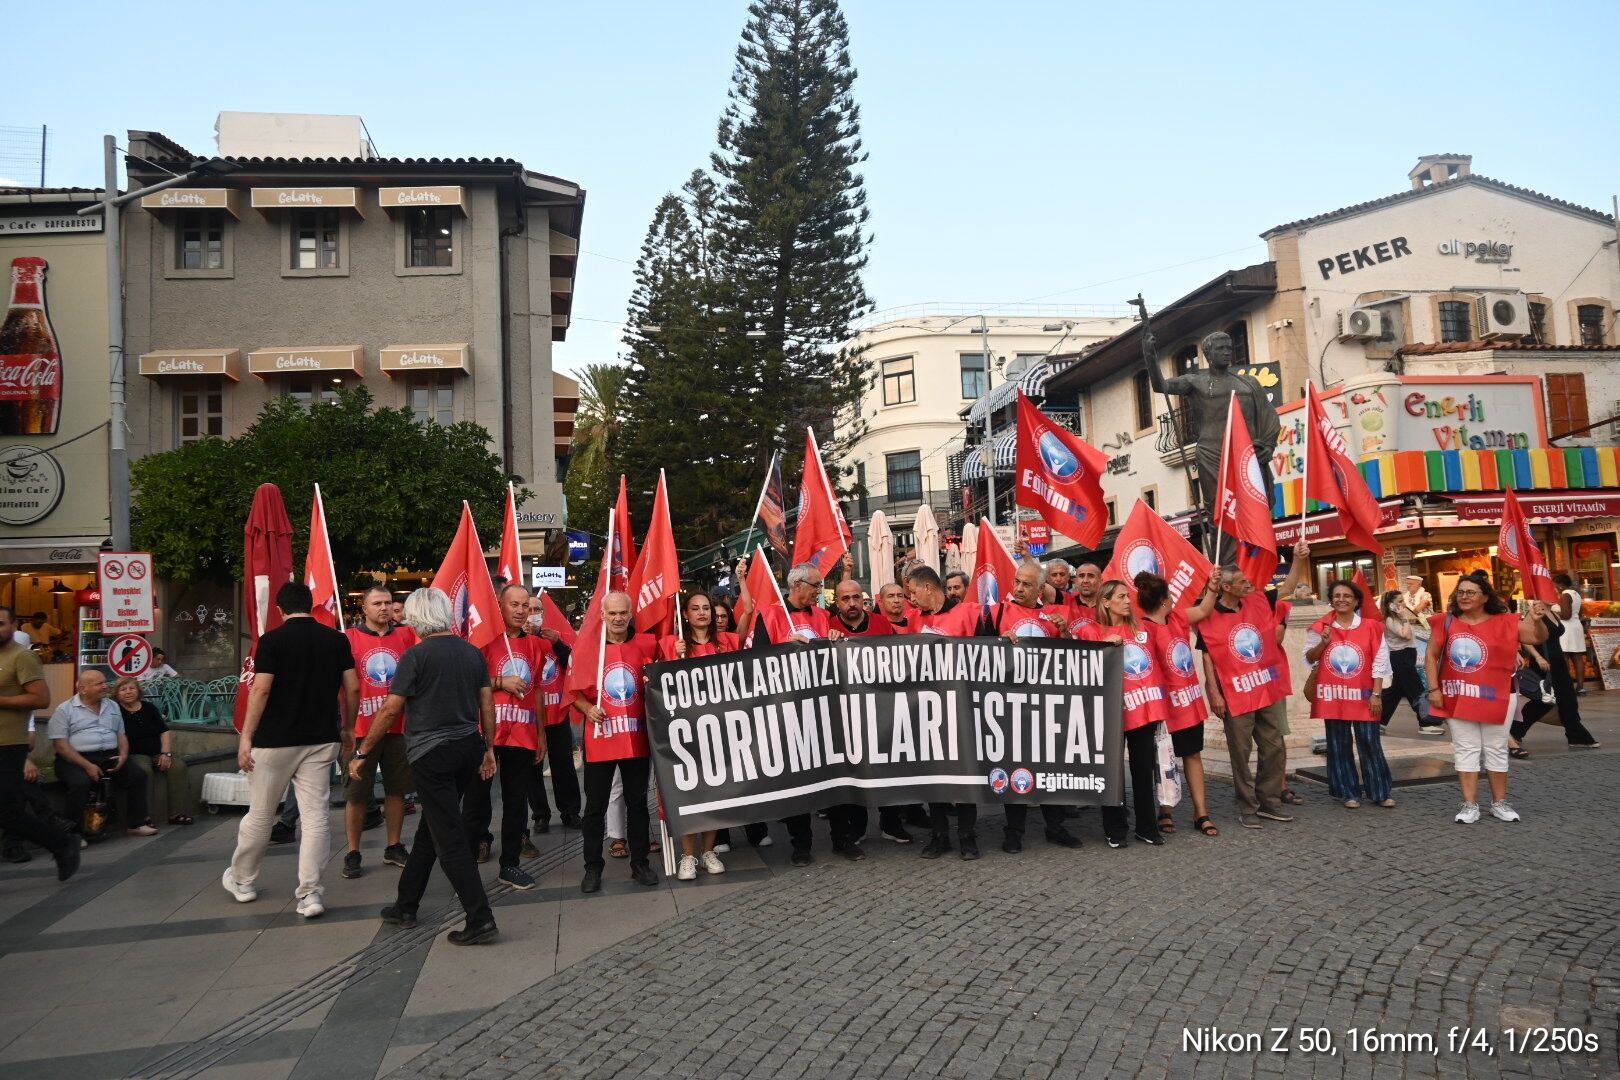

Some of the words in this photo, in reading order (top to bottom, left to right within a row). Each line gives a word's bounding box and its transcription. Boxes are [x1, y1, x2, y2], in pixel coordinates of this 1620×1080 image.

[1317, 236, 1412, 280] PEKER
[660, 647, 840, 717] ÇOCUKLARIMIZI
[847, 644, 1005, 685] KORUYAMAYAN
[668, 690, 959, 791] SORUMLULARI
[1035, 772, 1106, 793] Eğitimiş
